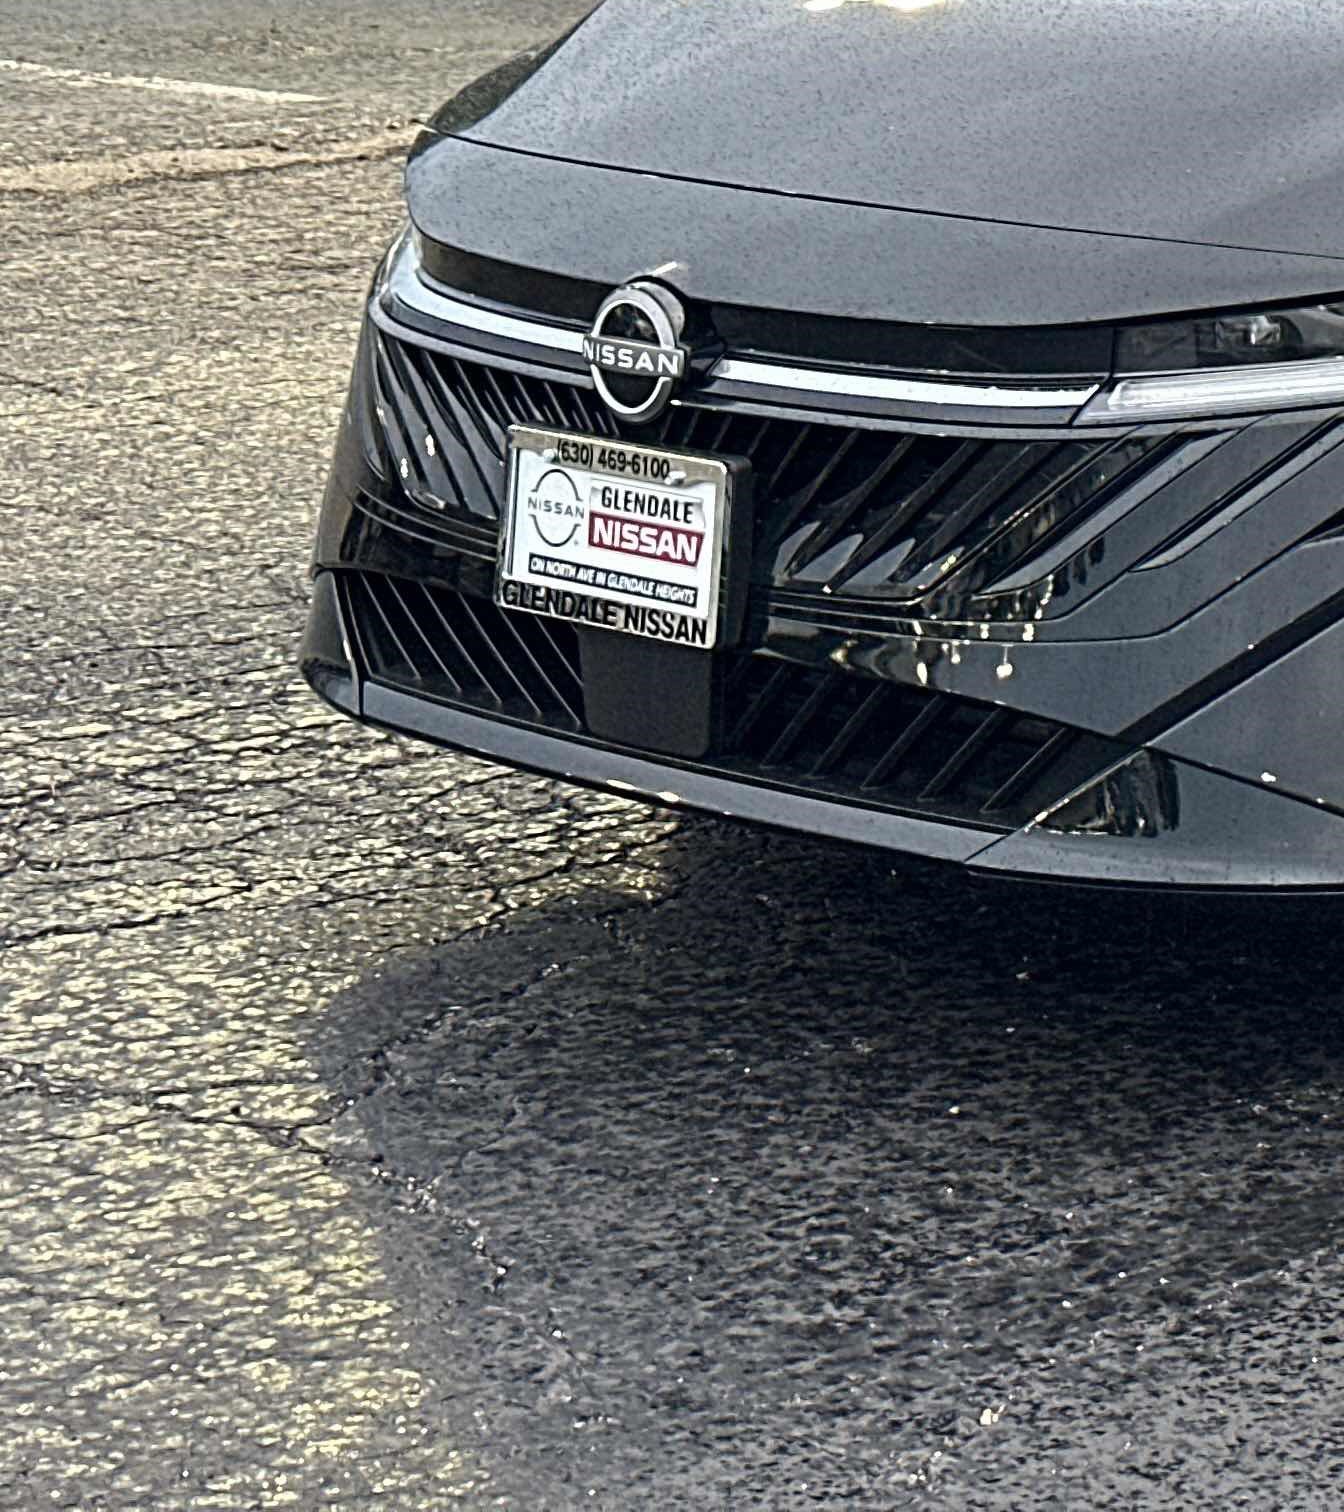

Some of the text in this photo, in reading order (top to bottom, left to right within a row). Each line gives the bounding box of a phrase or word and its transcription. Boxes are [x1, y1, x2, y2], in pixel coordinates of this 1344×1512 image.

[583, 339, 679, 375] NISSAN
[557, 438, 671, 480] (630) 469-6100
[527, 495, 585, 520] NISSAN
[601, 485, 694, 523] GLENDALE
[593, 517, 699, 562] NISSAN
[530, 557, 695, 604] ON NORTH AVE IN GLENDALE HEIGHTS
[502, 580, 708, 645] GLENDALE NISSAN
